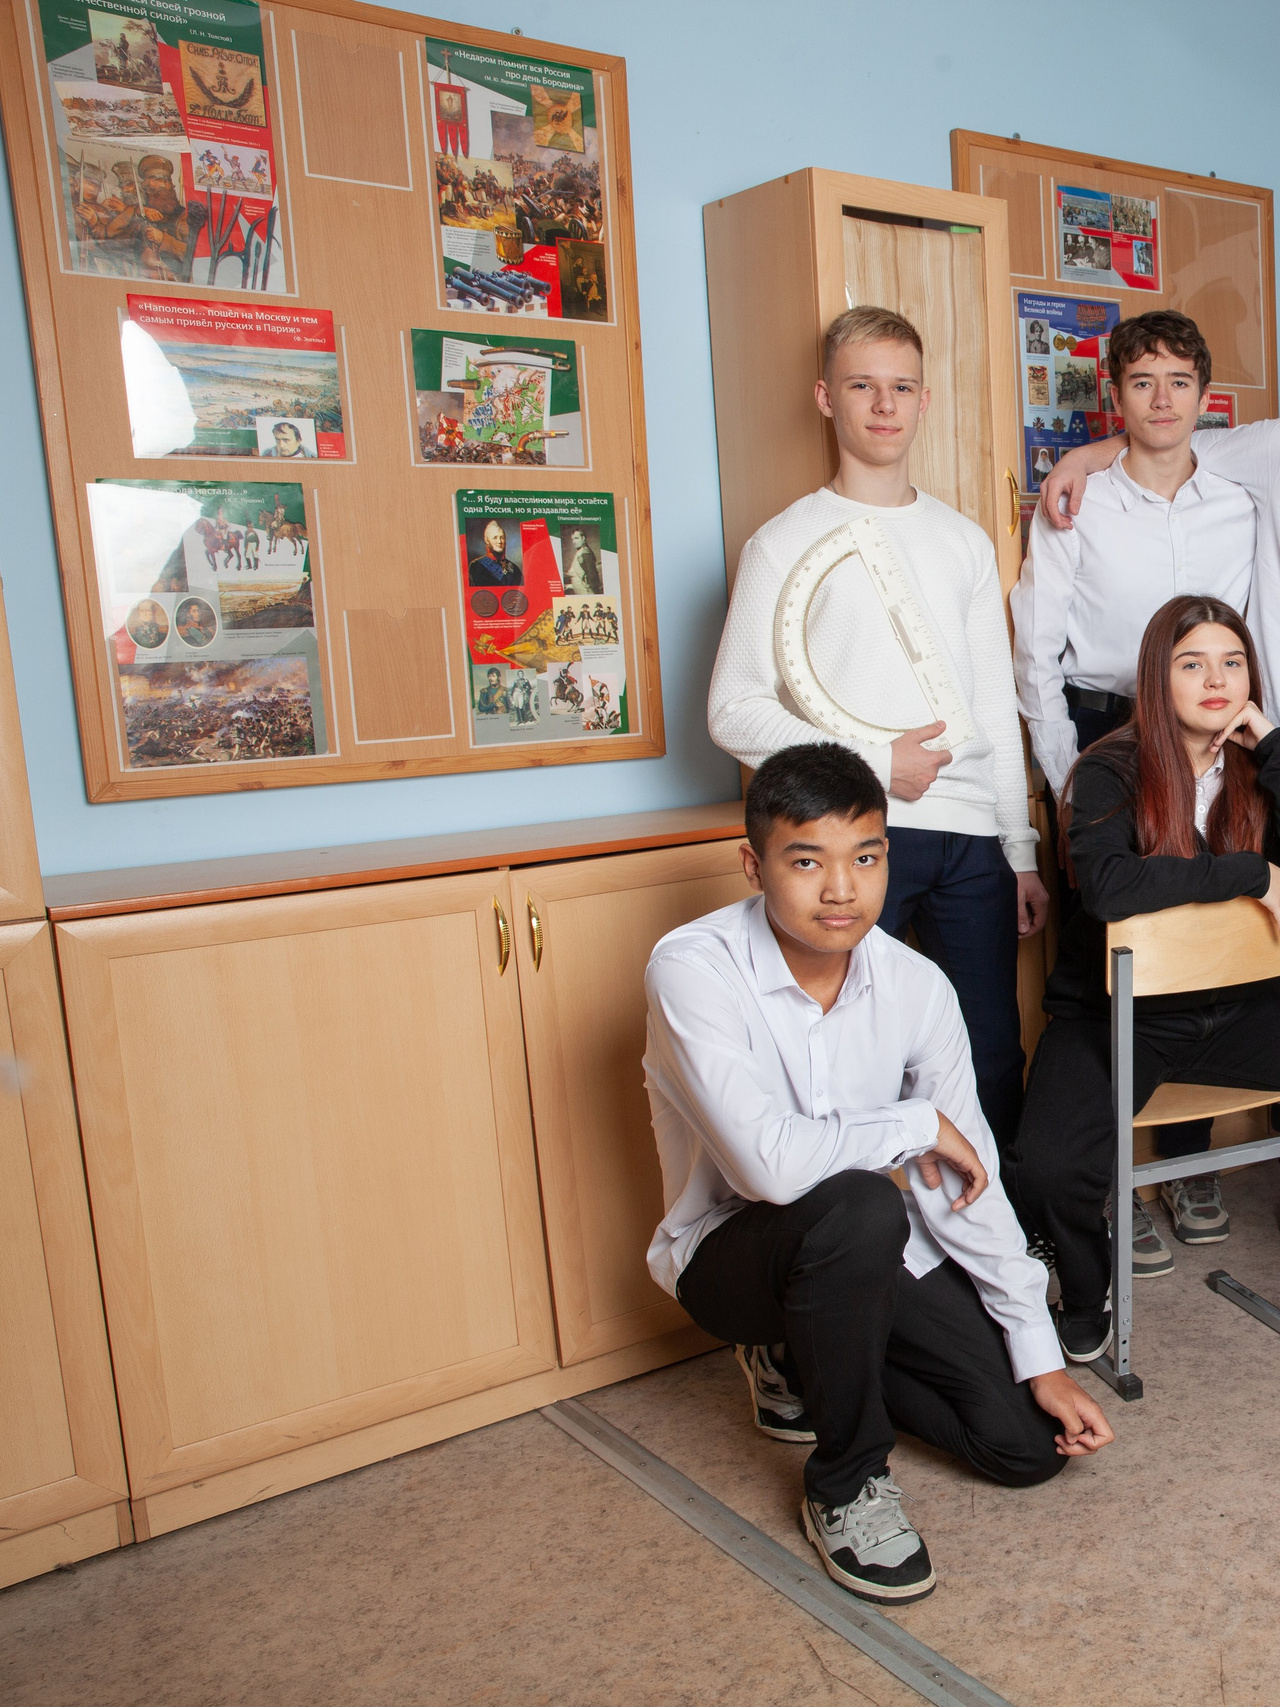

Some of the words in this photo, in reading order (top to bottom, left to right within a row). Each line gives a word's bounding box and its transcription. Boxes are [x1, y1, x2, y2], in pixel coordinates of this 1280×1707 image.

[149, 11, 188, 25] силой»
[183, 6, 226, 22] грозной
[454, 50, 496, 64] «Недаром
[497, 58, 528, 71] помнит
[529, 65, 543, 74] вся
[544, 66, 571, 79] Россия
[505, 70, 521, 80] про
[522, 73, 541, 84] день
[542, 76, 584, 91] Бородина»
[1023, 298, 1046, 308] Награды
[207, 308, 239, 320] пошёл
[241, 312, 253, 320] на
[255, 311, 291, 325] Москву
[300, 316, 318, 325] тем
[1023, 306, 1046, 314] Великой
[1046, 308, 1063, 316] войны
[139, 315, 175, 325] самым
[176, 317, 213, 329] привёл
[215, 321, 254, 332] русских
[263, 323, 301, 335] Париж»
[477, 495, 484, 503] Я
[484, 495, 503, 505] буду
[504, 496, 554, 505] властелином
[577, 497, 608, 505] остаётся
[463, 506, 483, 515] одна
